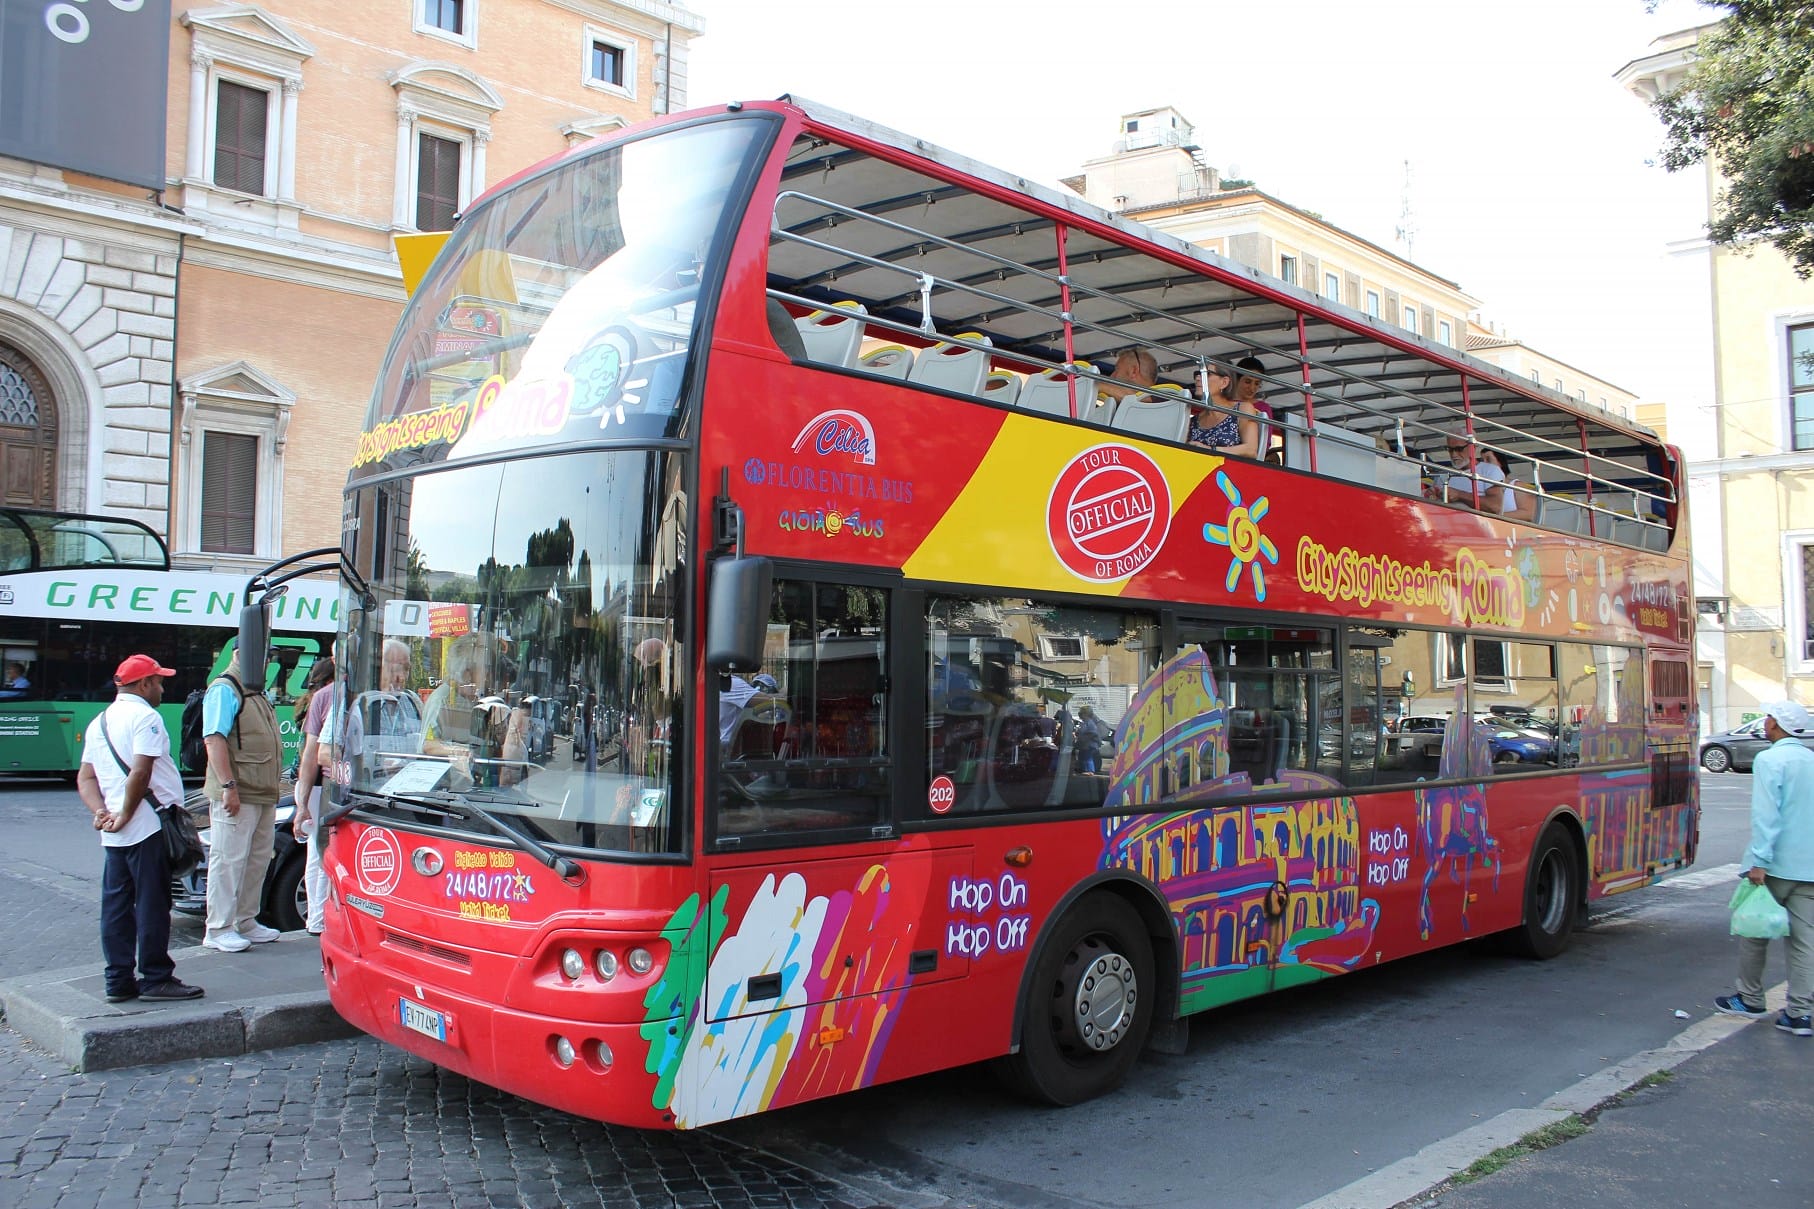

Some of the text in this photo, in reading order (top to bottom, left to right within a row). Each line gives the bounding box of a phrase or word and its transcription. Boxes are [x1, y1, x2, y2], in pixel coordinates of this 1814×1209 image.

[816, 420, 871, 455] Cilia
[1080, 449, 1121, 472] TOUR
[767, 462, 913, 503] FLORENTIA BUS
[1070, 492, 1152, 534] OFFICIAL
[1095, 543, 1152, 577] OF ROMA
[1457, 547, 1526, 628] Roma
[931, 787, 953, 801] 202
[368, 829, 384, 838] TOUR
[1370, 827, 1408, 854] Hop On
[363, 855, 392, 868] OFFICIAL
[455, 851, 515, 869] Biglietto Valido
[1368, 858, 1409, 886] Hop Off
[446, 872, 512, 898] 24/48/72
[951, 874, 1026, 913] Hop On
[460, 902, 510, 922] Valid Ticket
[948, 917, 1029, 957] Hop Off
